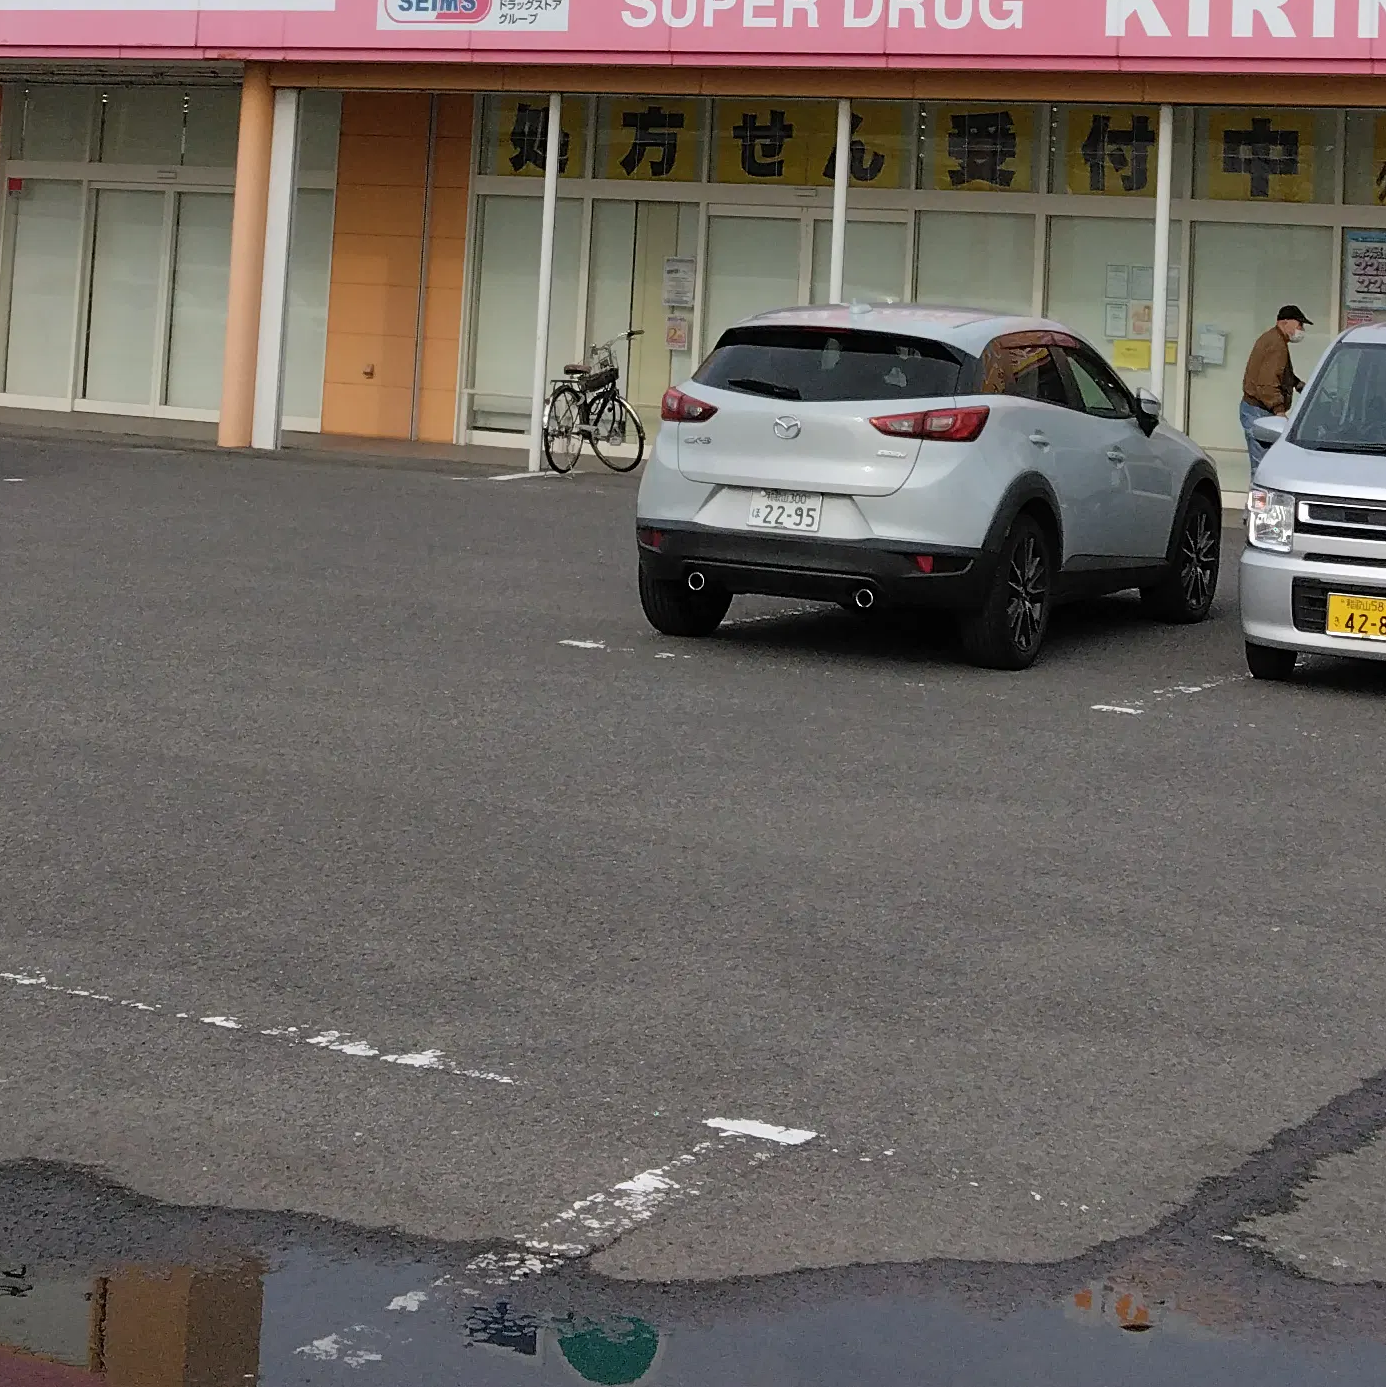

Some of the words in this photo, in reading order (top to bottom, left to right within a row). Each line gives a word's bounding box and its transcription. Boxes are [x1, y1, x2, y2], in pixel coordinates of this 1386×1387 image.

[499, 0, 562, 11] ドラッグストア
[499, 13, 539, 25] グループ
[762, 504, 817, 528] 22-95
